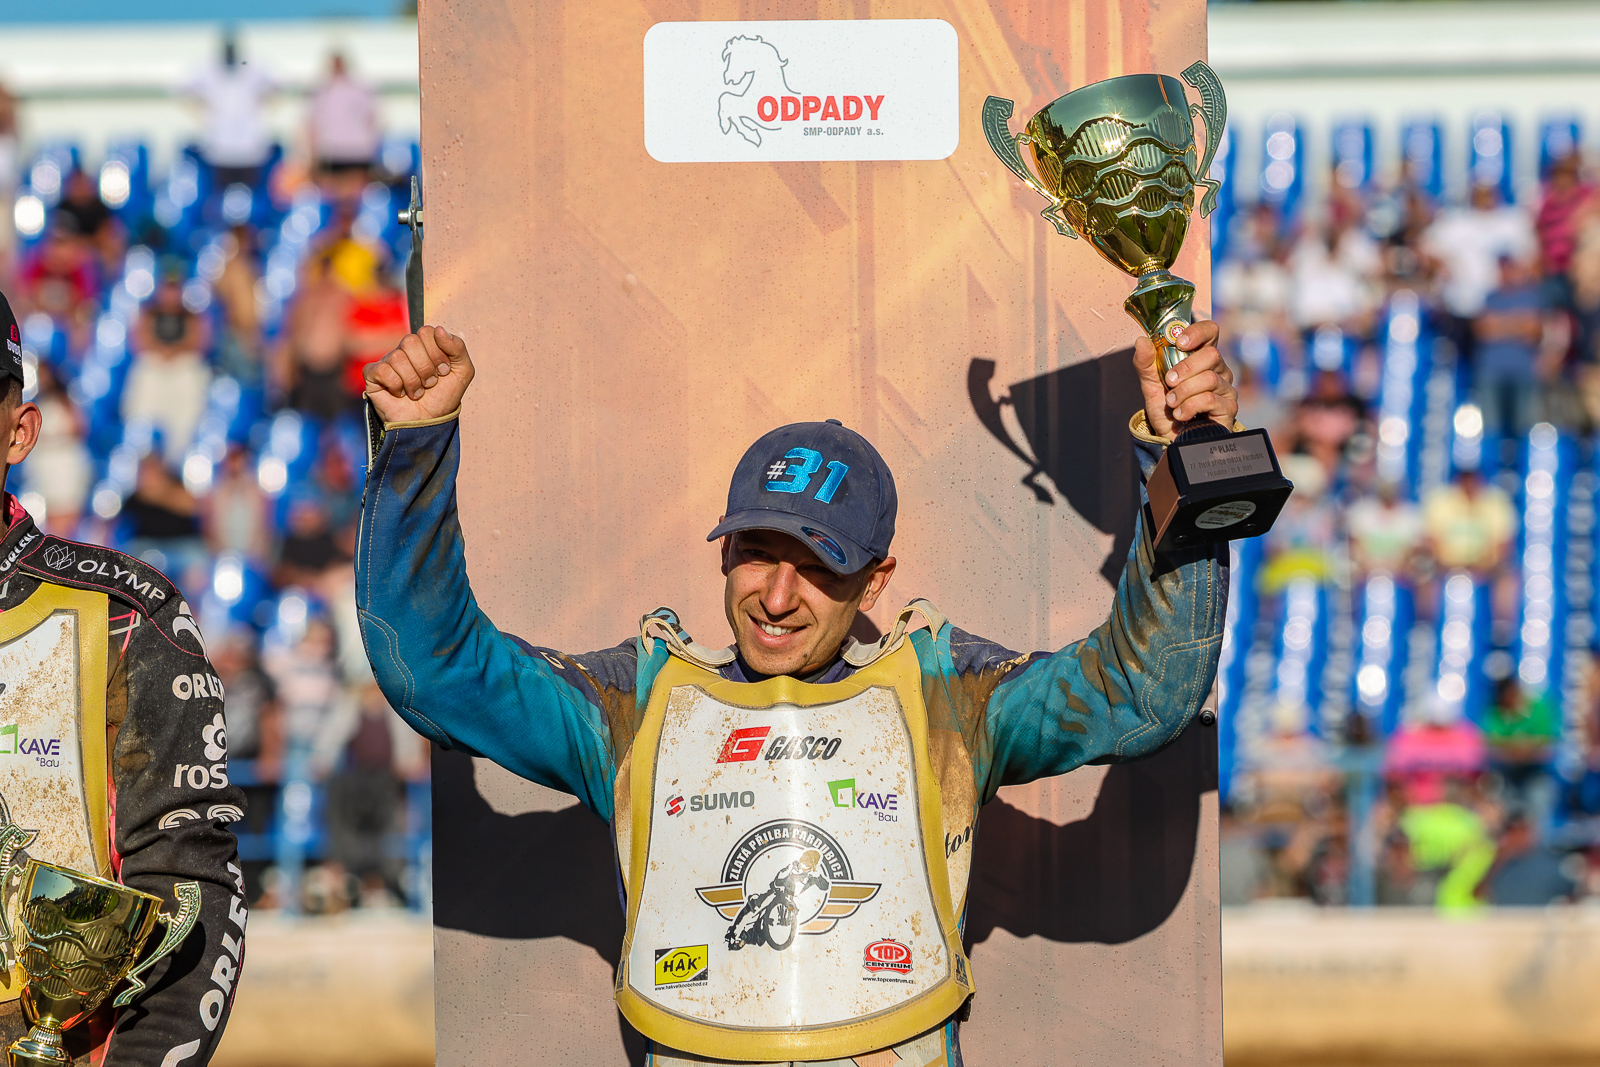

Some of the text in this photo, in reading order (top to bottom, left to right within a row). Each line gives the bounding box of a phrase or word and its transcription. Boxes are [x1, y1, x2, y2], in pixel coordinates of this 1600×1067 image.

[757, 95, 885, 122] ODPADY
[803, 126, 884, 136] SMP-ODPADY a.s.
[1218, 443, 1238, 454] PLACE
[765, 447, 850, 504] #31
[77, 559, 166, 601] OLYMP
[19, 738, 60, 755] KAVE
[764, 735, 842, 761] GASCO
[690, 790, 755, 812] SUMO
[857, 792, 898, 810] KAVE
[729, 827, 844, 880] ZLATÁ PŘILBA PARDUBICE
[873, 945, 904, 960] TOP
[663, 958, 698, 973] HAK
[865, 961, 910, 969] CENTRUM
